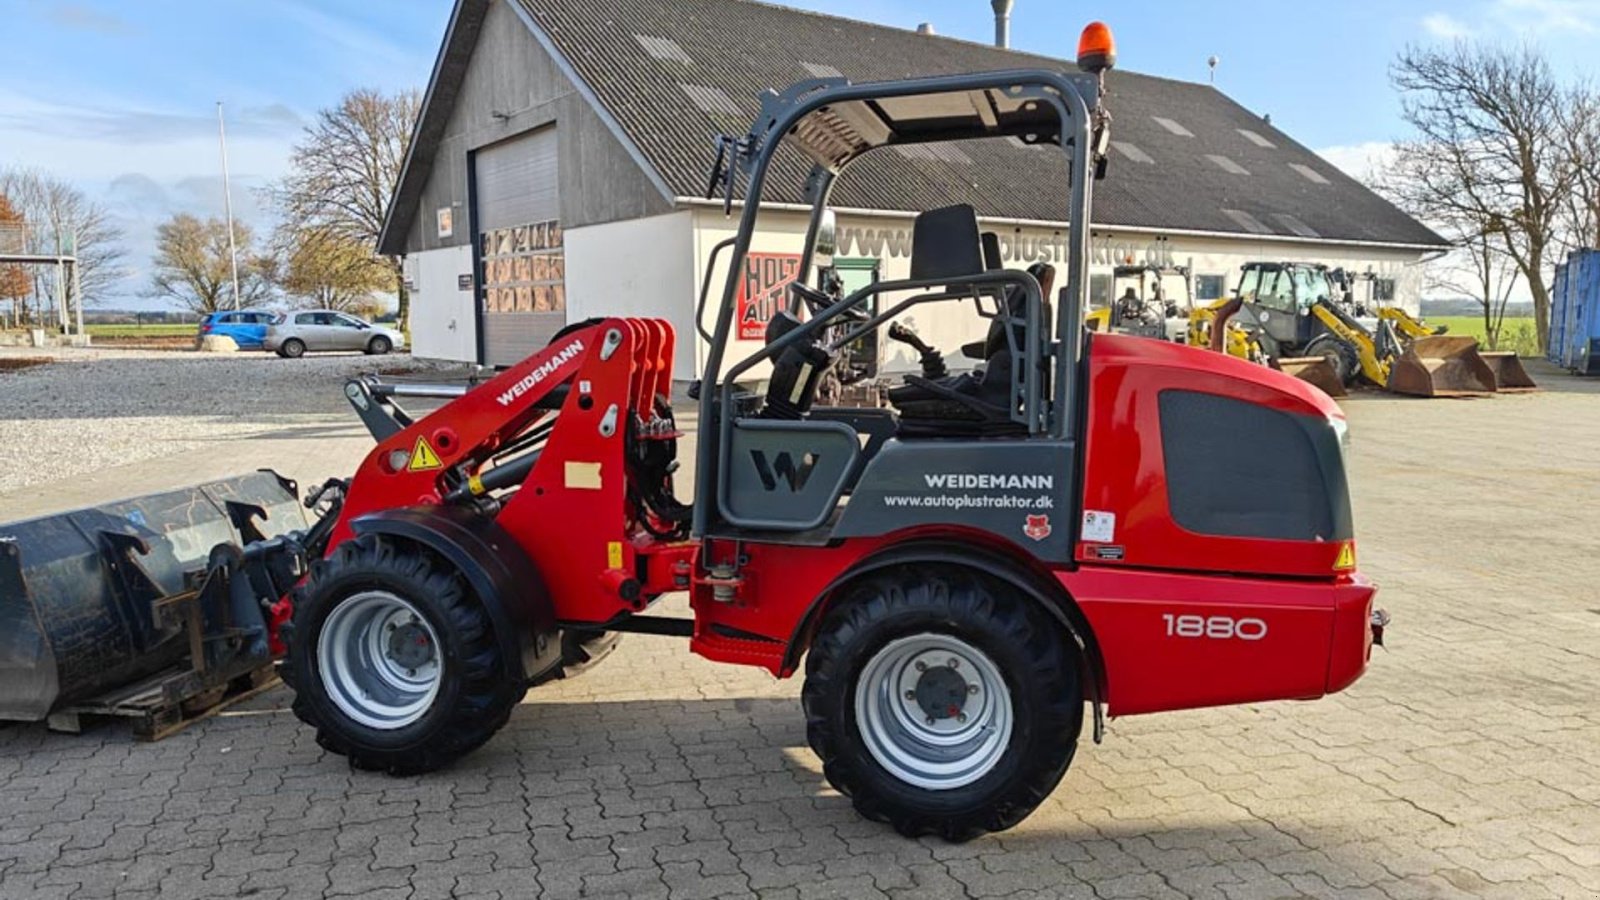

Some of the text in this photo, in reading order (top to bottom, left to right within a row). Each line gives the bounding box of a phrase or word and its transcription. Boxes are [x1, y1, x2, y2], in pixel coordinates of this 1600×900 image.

[745, 256, 799, 300] HOLT
[496, 340, 584, 406] WEIDEMANN
[924, 474, 1054, 490] WEIDEMANN
[884, 493, 1054, 510] www.autoplustraktor.dk
[1162, 613, 1267, 640] 1880
